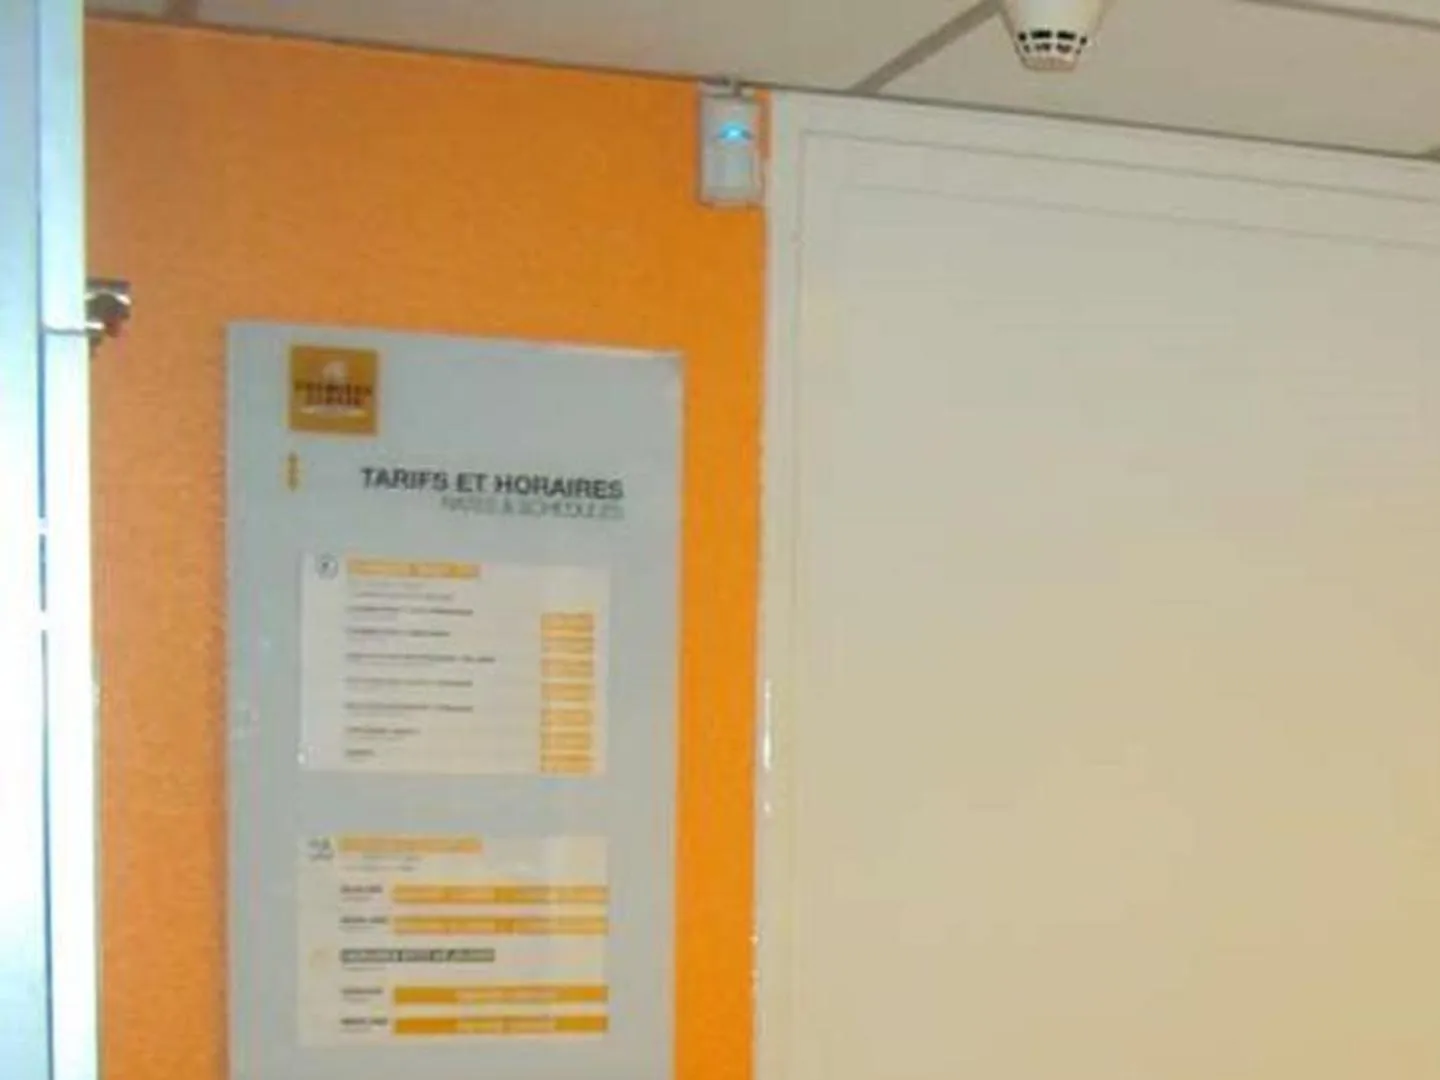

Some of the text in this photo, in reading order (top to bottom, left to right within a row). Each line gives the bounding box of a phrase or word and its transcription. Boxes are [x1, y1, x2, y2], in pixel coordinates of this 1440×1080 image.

[361, 466, 624, 500] TARIFS ET HORAIRES
